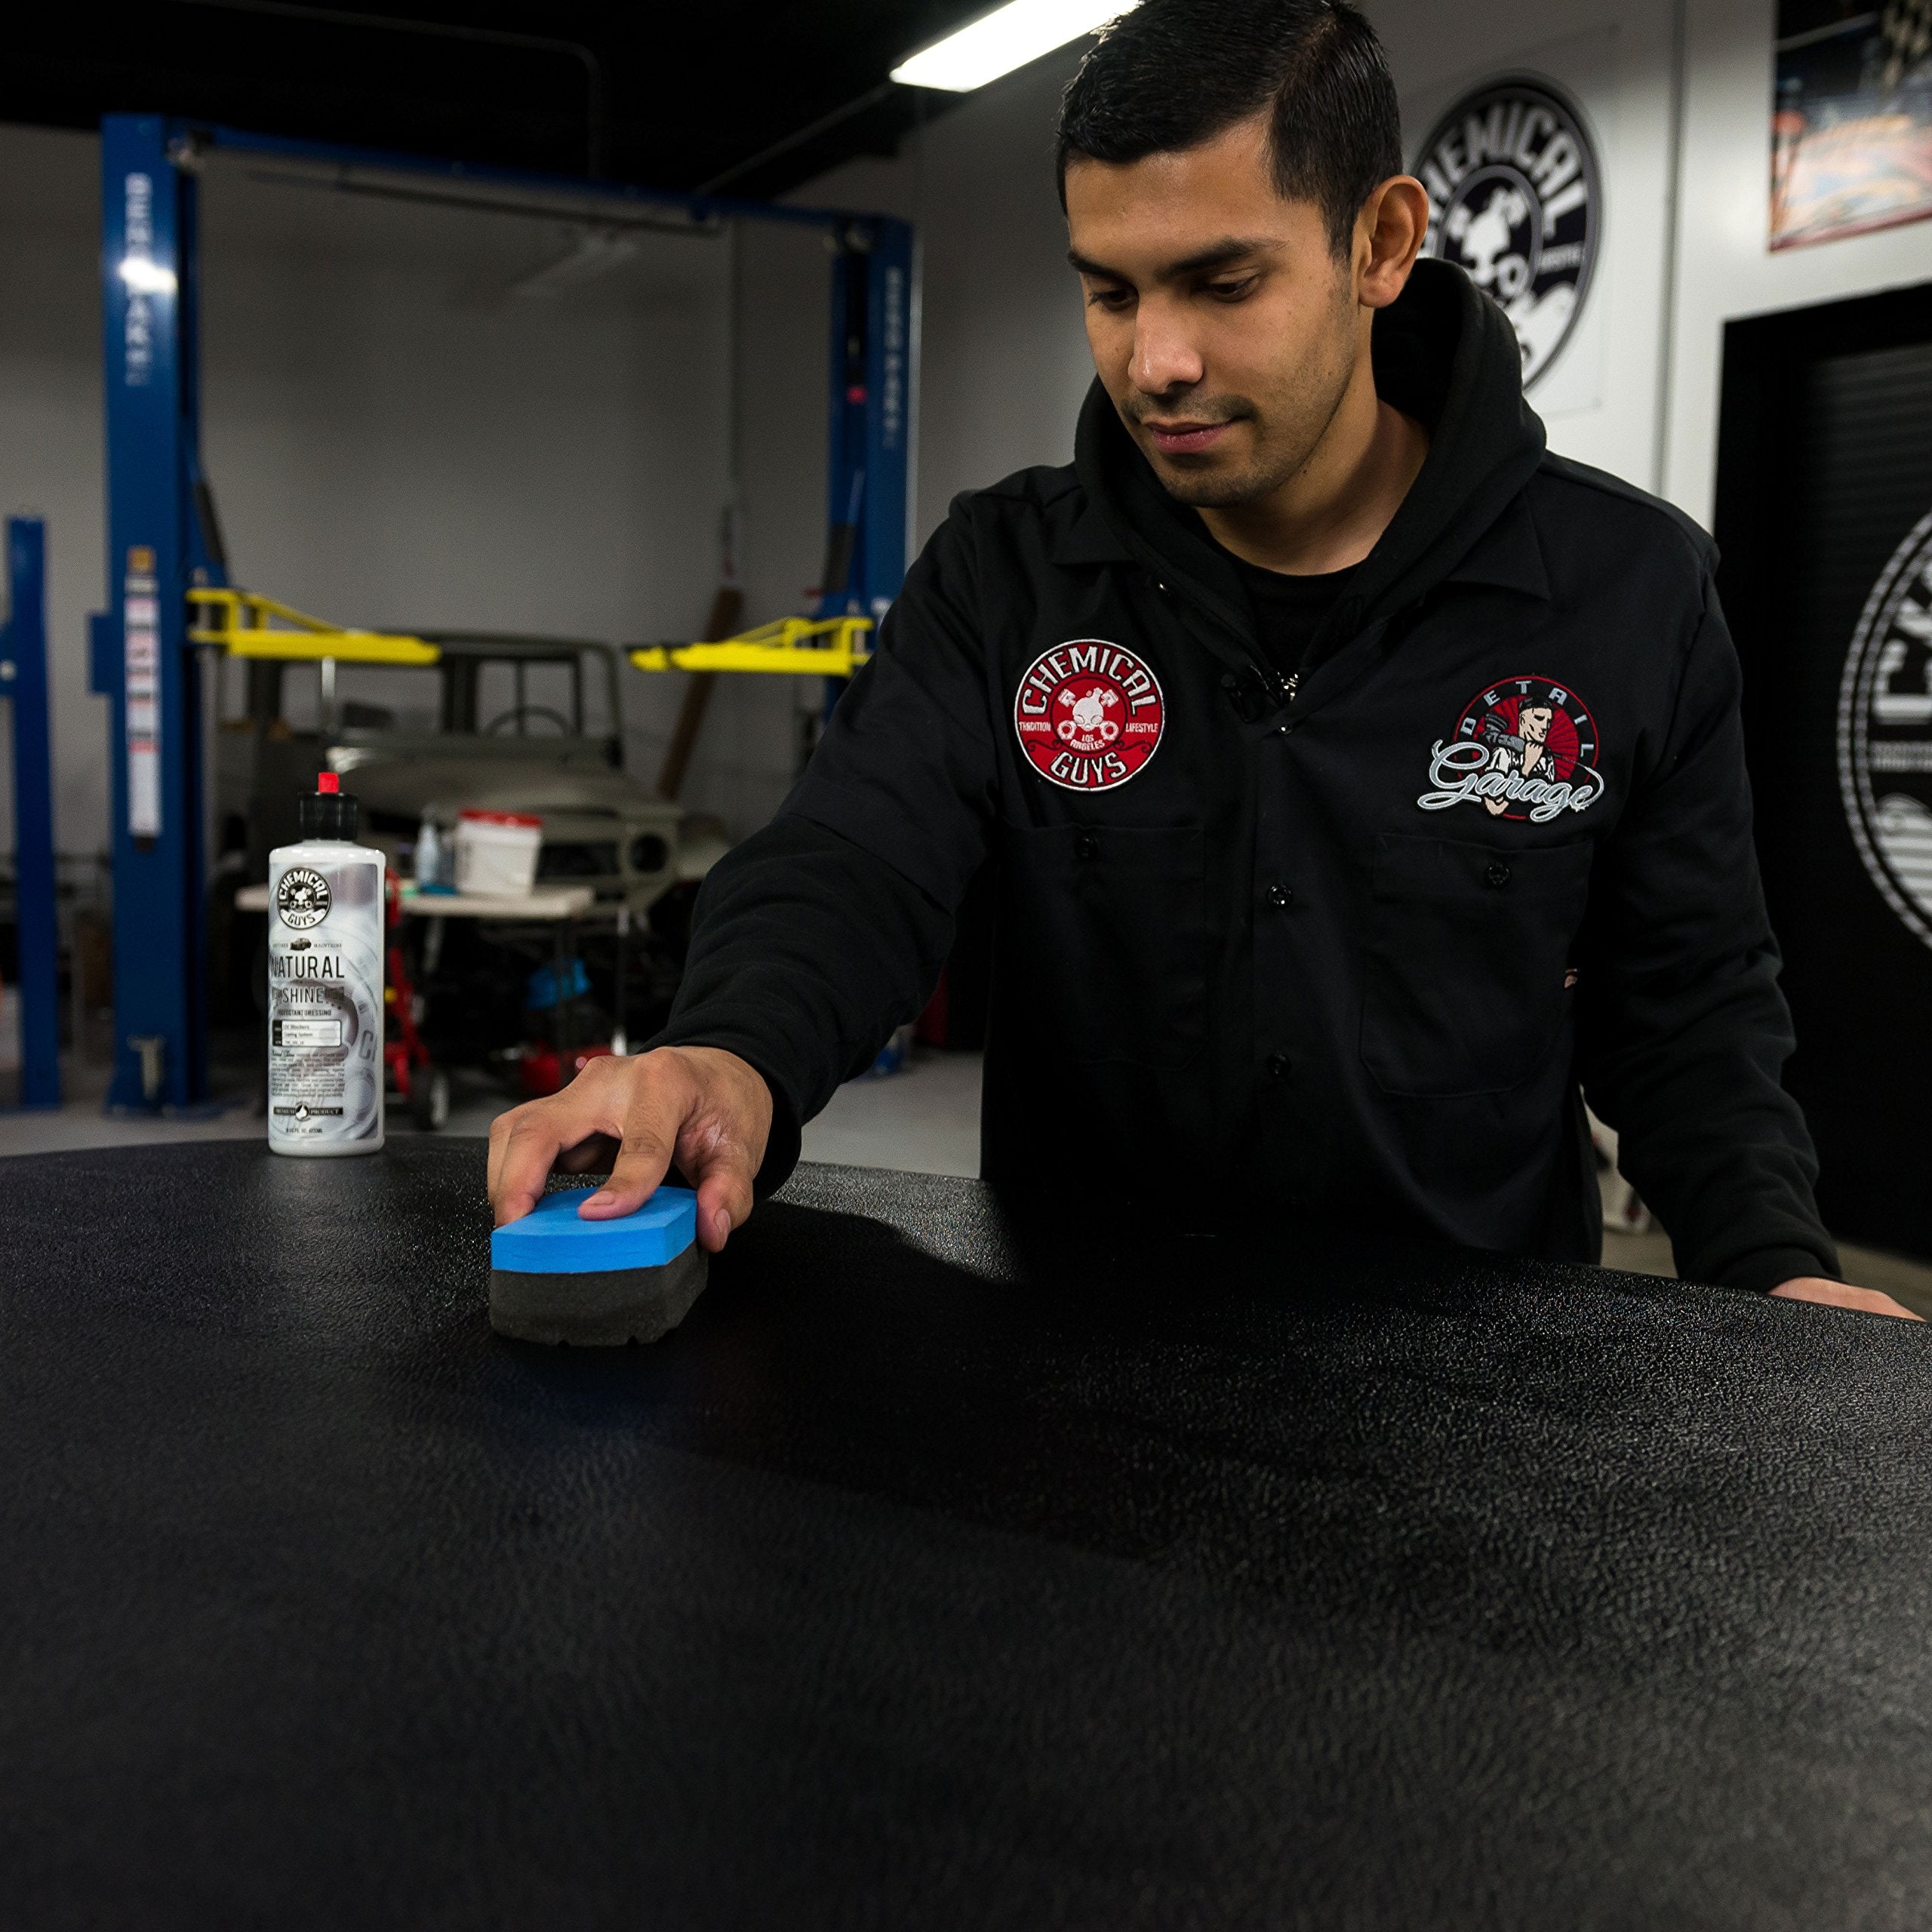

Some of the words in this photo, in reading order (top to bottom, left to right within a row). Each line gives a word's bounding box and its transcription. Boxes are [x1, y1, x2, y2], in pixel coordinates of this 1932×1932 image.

[1023, 645, 1156, 715] CHEMICAL
[1018, 721, 1052, 732] TRADITION
[1125, 721, 1159, 733] LIFESTYLE
[1460, 680, 1595, 757] DETAIL
[1069, 739, 1106, 751] ANGELES
[1081, 734, 1094, 743] LOS
[1050, 751, 1128, 784] GUYS
[1417, 739, 1604, 823] Garage
[278, 870, 328, 900] CHEMICAL
[288, 913, 315, 926] GUYS
[270, 955, 345, 978] NATURAL
[282, 988, 324, 1004] SHINE
